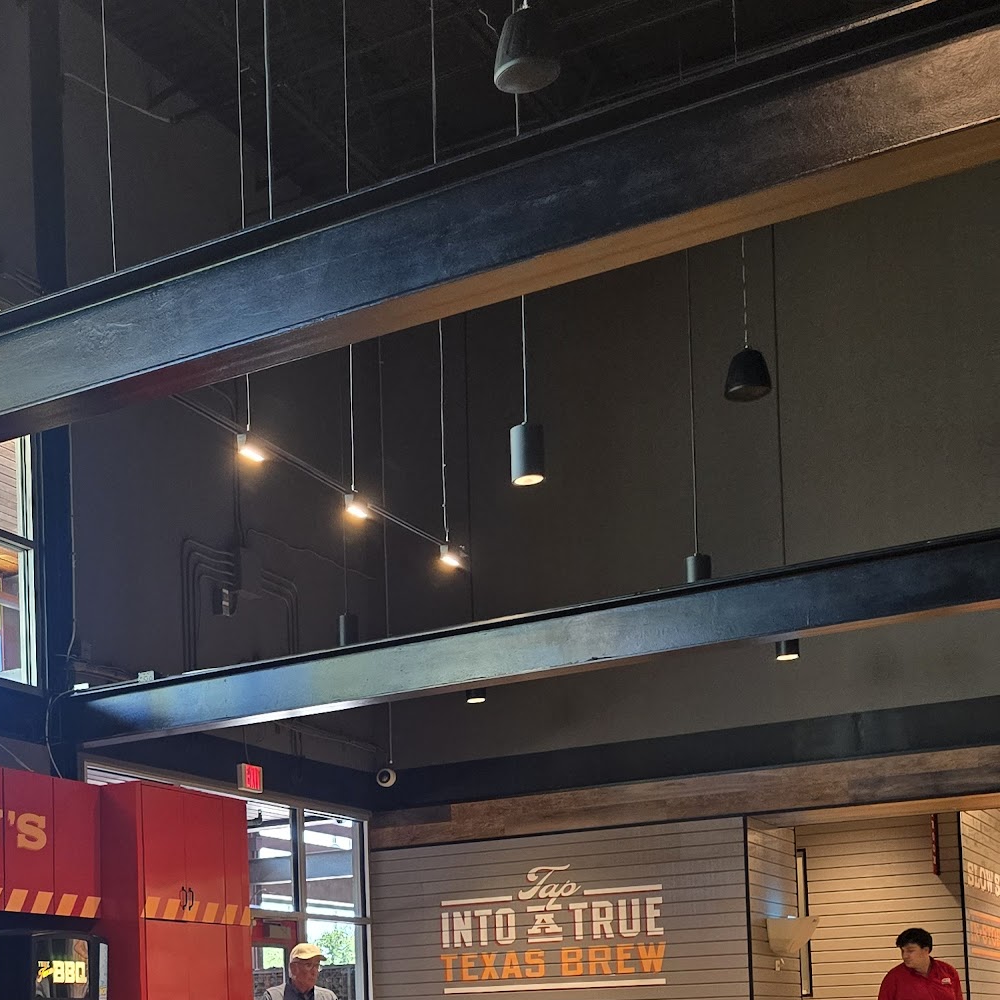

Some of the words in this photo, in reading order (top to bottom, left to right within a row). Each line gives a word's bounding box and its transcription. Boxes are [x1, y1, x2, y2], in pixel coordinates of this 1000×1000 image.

[518, 864, 581, 911] Tap
[967, 861, 994, 893] SLOW
[441, 907, 516, 948] INTO
[527, 913, 563, 935] A
[568, 896, 664, 941] TRUE
[52, 960, 88, 984] BBQ
[440, 948, 545, 982] TEXAS
[561, 941, 667, 977] BREW
